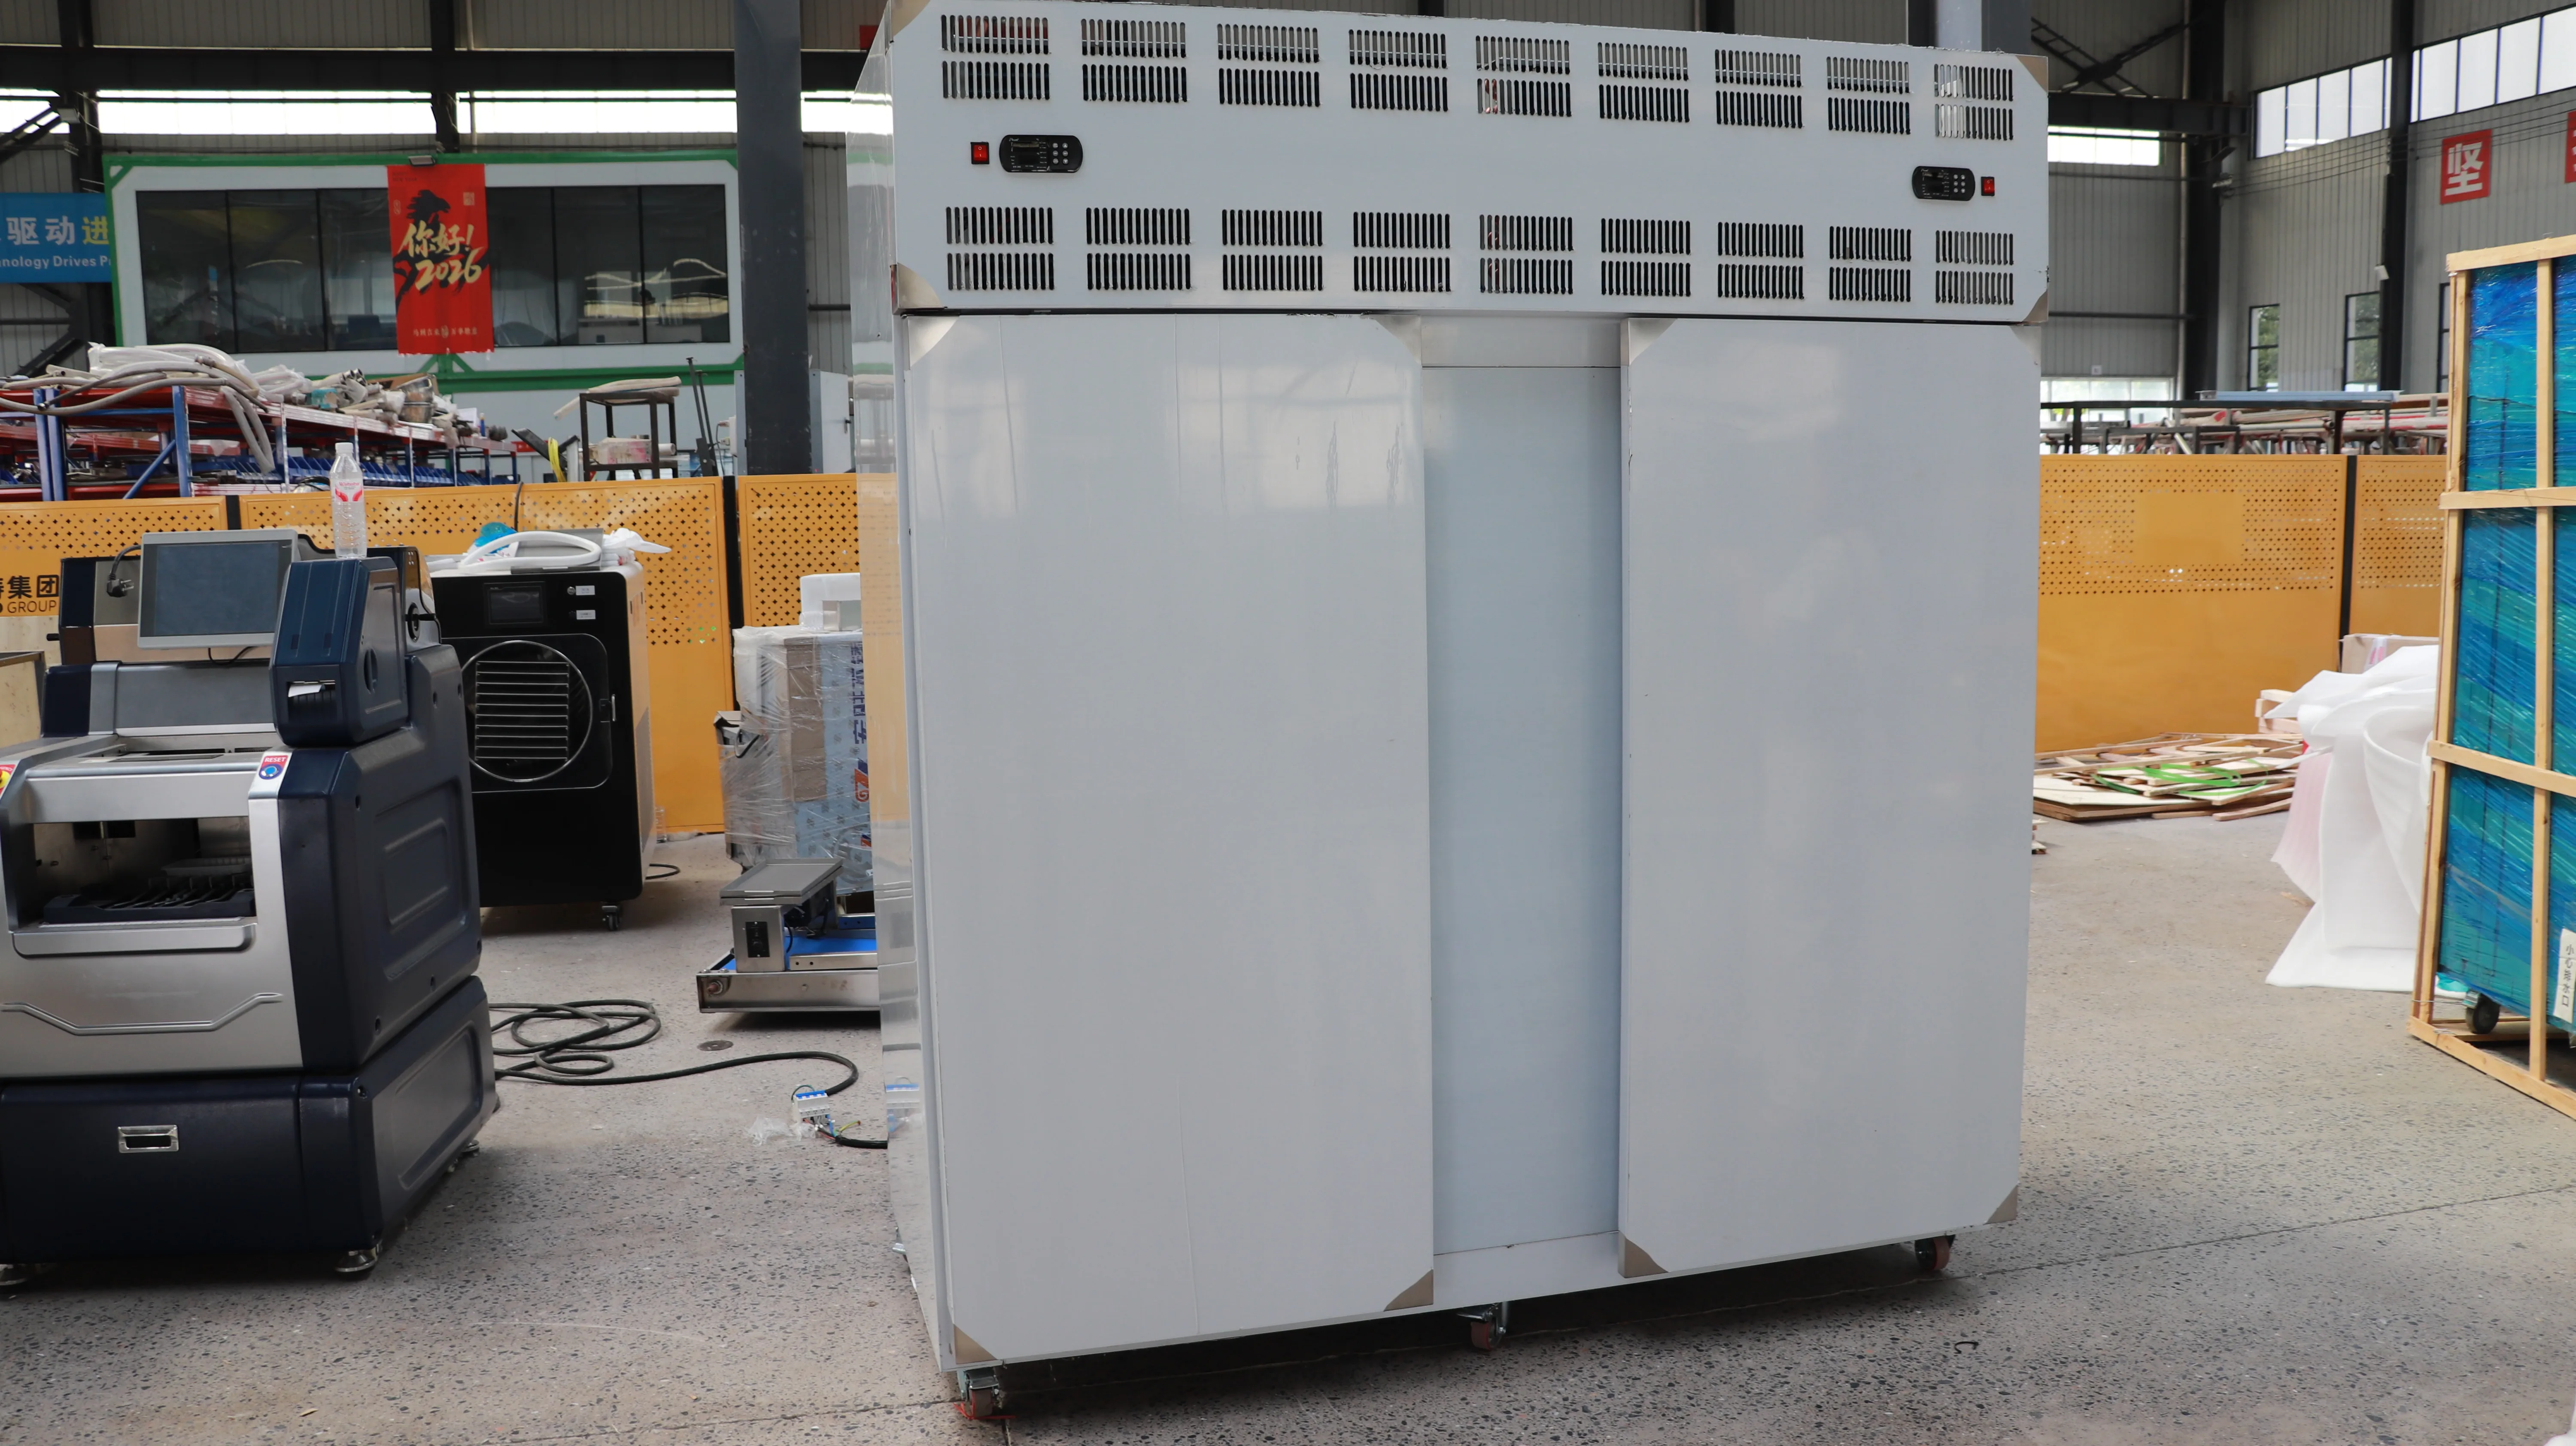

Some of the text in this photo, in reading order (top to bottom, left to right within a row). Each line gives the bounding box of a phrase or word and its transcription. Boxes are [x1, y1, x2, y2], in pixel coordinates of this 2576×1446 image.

[2445, 142, 2484, 196] 坚
[6, 216, 109, 245] 驱动进
[0, 256, 49, 269] nology
[53, 255, 96, 267] Drives
[415, 246, 484, 291] 2026
[0, 574, 59, 599] 集团
[7, 600, 56, 613] GROUP
